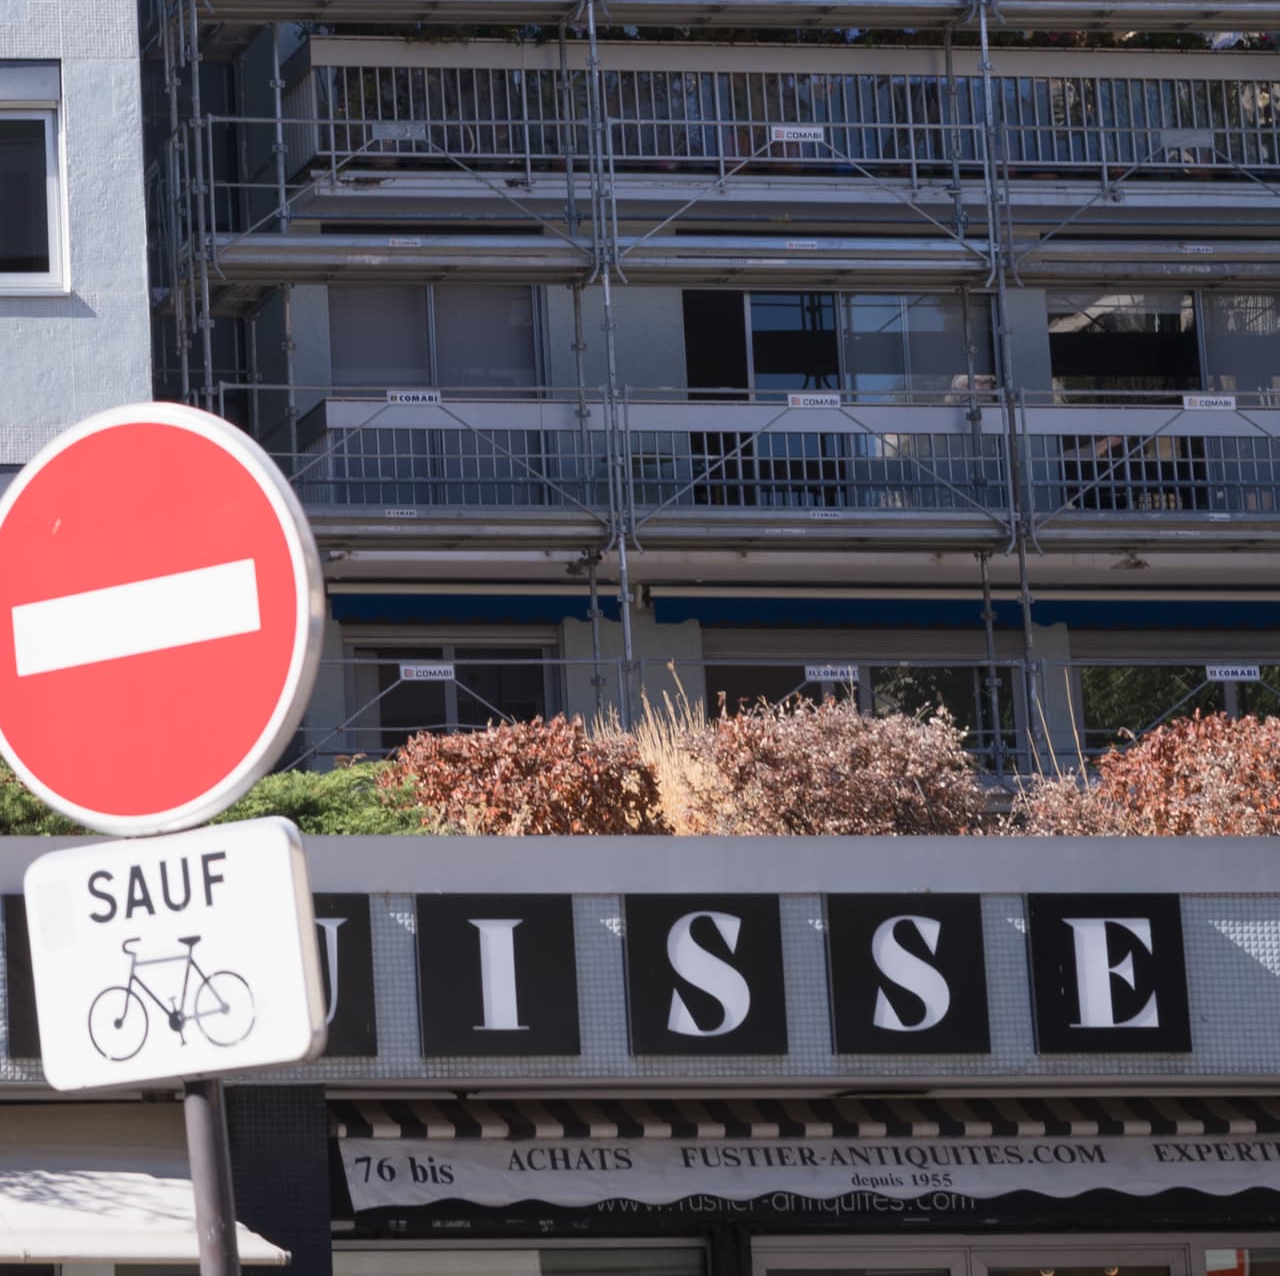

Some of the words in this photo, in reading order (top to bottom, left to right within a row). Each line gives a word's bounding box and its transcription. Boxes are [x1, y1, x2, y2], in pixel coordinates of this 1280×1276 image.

[786, 131, 822, 139] COMABI
[399, 395, 438, 403] COMABI
[803, 398, 838, 406] COMABI
[1199, 399, 1232, 407] COMABI
[416, 670, 452, 678] COMABI
[1218, 669, 1257, 677] COMABI
[88, 850, 227, 924] SAUF
[314, 909, 1159, 1037] ISSE
[507, 1146, 634, 1172] ACHATS
[680, 1143, 1107, 1170] FUSTIER-ANTIQUITES.COM
[354, 1155, 397, 1183] 76
[408, 1155, 455, 1185] bis
[851, 1172, 903, 1189] depuis
[910, 1172, 953, 1188] 1955
